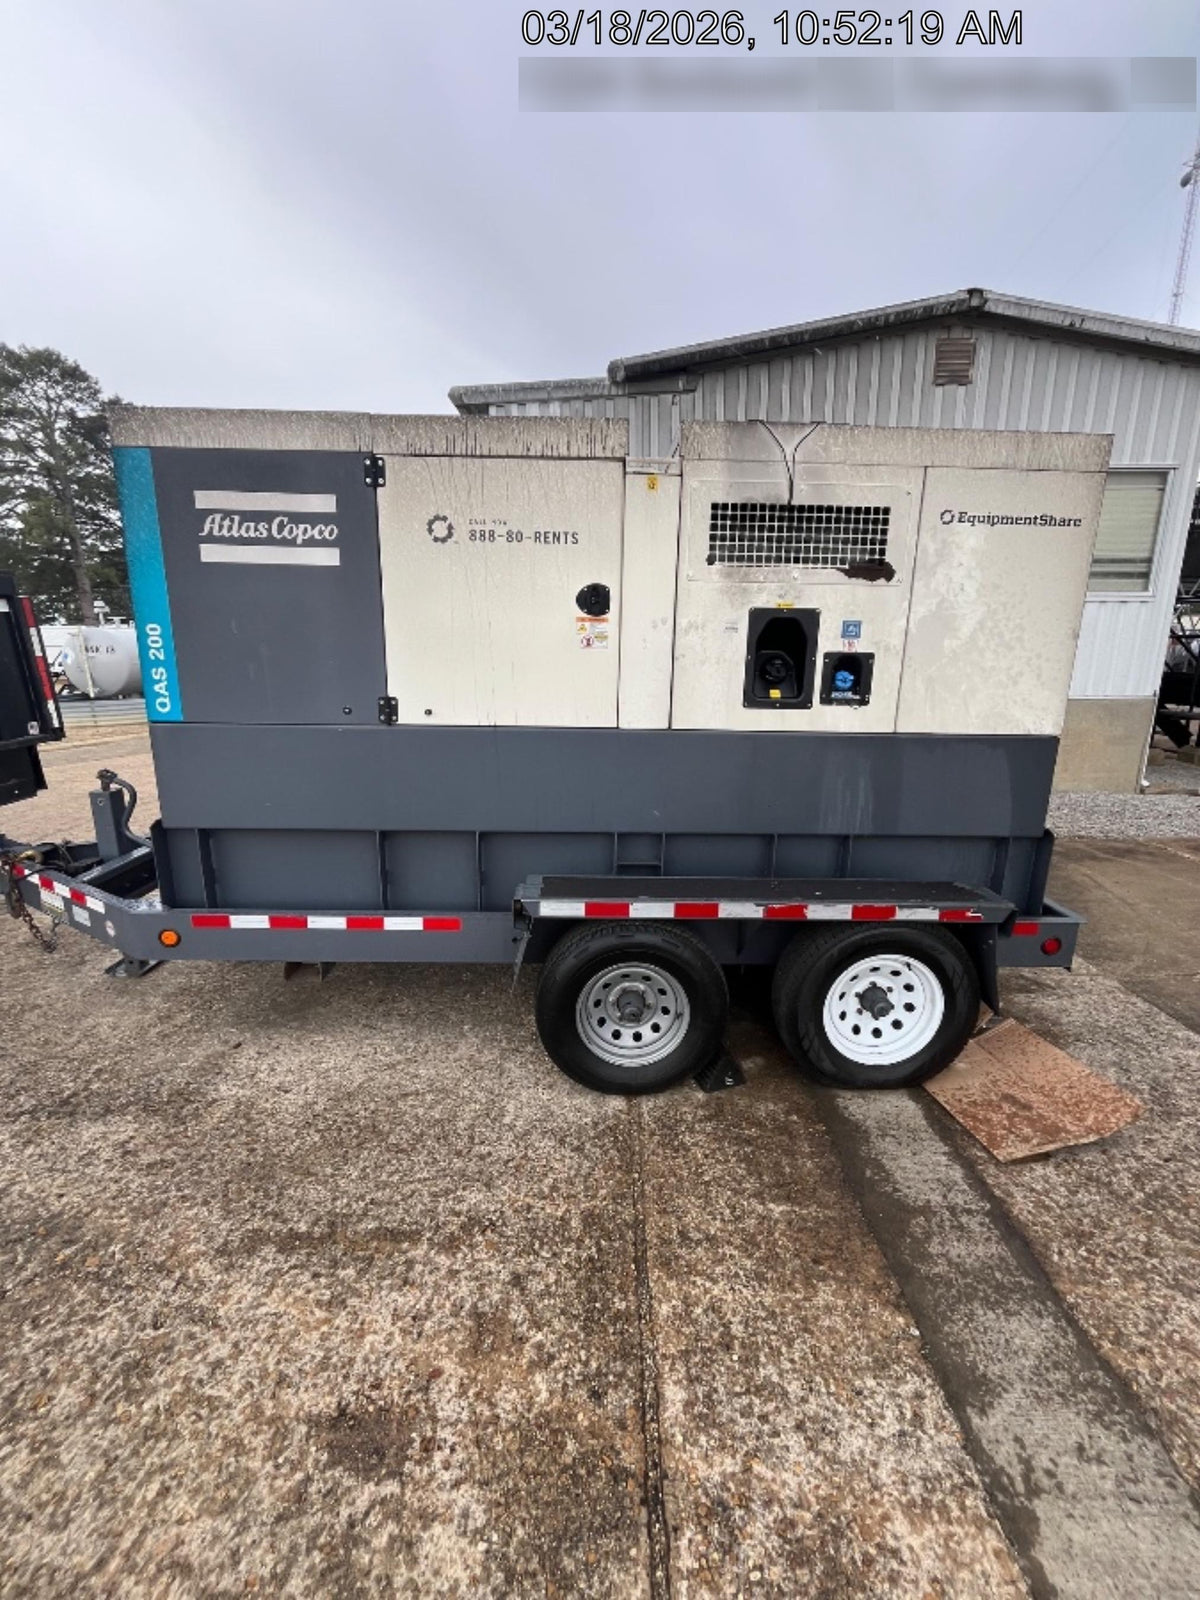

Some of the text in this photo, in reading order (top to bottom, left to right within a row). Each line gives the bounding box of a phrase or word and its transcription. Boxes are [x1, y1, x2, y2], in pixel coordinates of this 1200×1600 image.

[199, 513, 338, 545] Atlas Copco
[957, 511, 1082, 528] EquipmentShare
[468, 529, 579, 546] 888-80-RENTS
[145, 623, 171, 714] QAS 200
